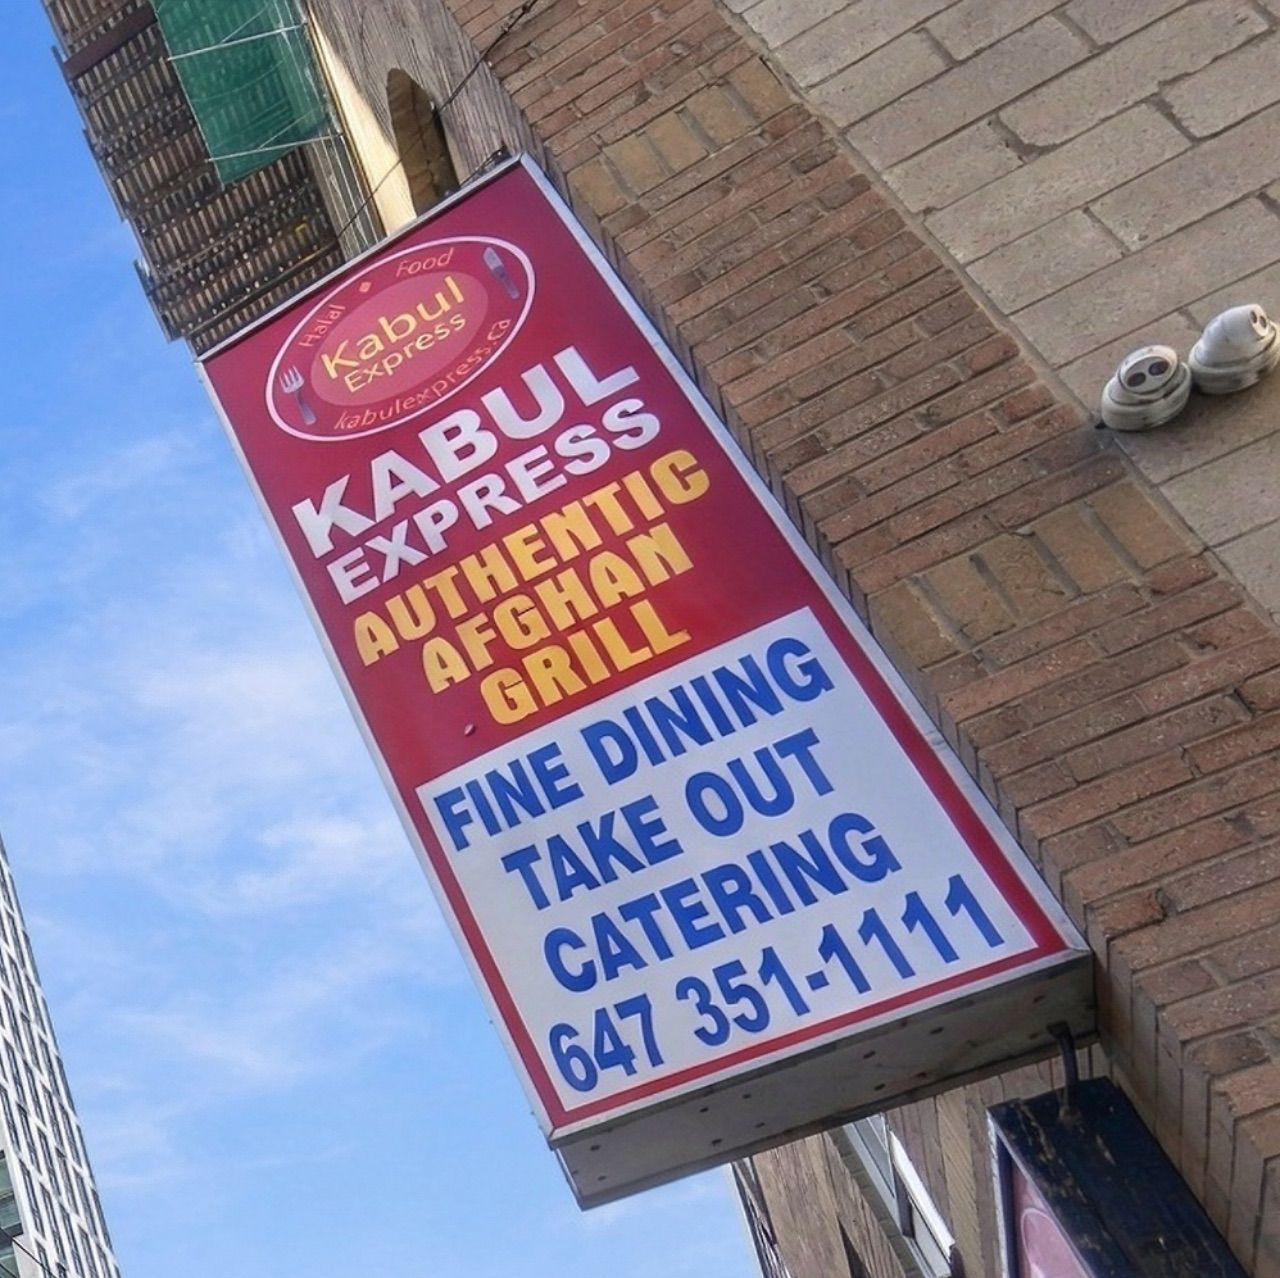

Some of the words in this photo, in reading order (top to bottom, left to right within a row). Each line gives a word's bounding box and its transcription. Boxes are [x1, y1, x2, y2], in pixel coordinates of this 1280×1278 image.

[298, 303, 346, 348] Halal
[395, 246, 455, 278] Food
[320, 275, 465, 379] Kabul
[333, 317, 512, 431] kabulexpress.ca
[342, 312, 467, 393] Express
[291, 342, 641, 559] KABUL
[326, 397, 661, 606] EXPRESS
[353, 448, 711, 667] AUTHENTIC
[421, 521, 695, 695] AFGHAN
[433, 741, 585, 852] FINE
[579, 636, 836, 786] DINING
[479, 598, 693, 726] GRILL
[500, 794, 685, 911] TAKE
[684, 726, 836, 838] OUT
[542, 811, 903, 994] CATERING
[548, 992, 666, 1093] 647
[675, 873, 1006, 1048] 351-1111
